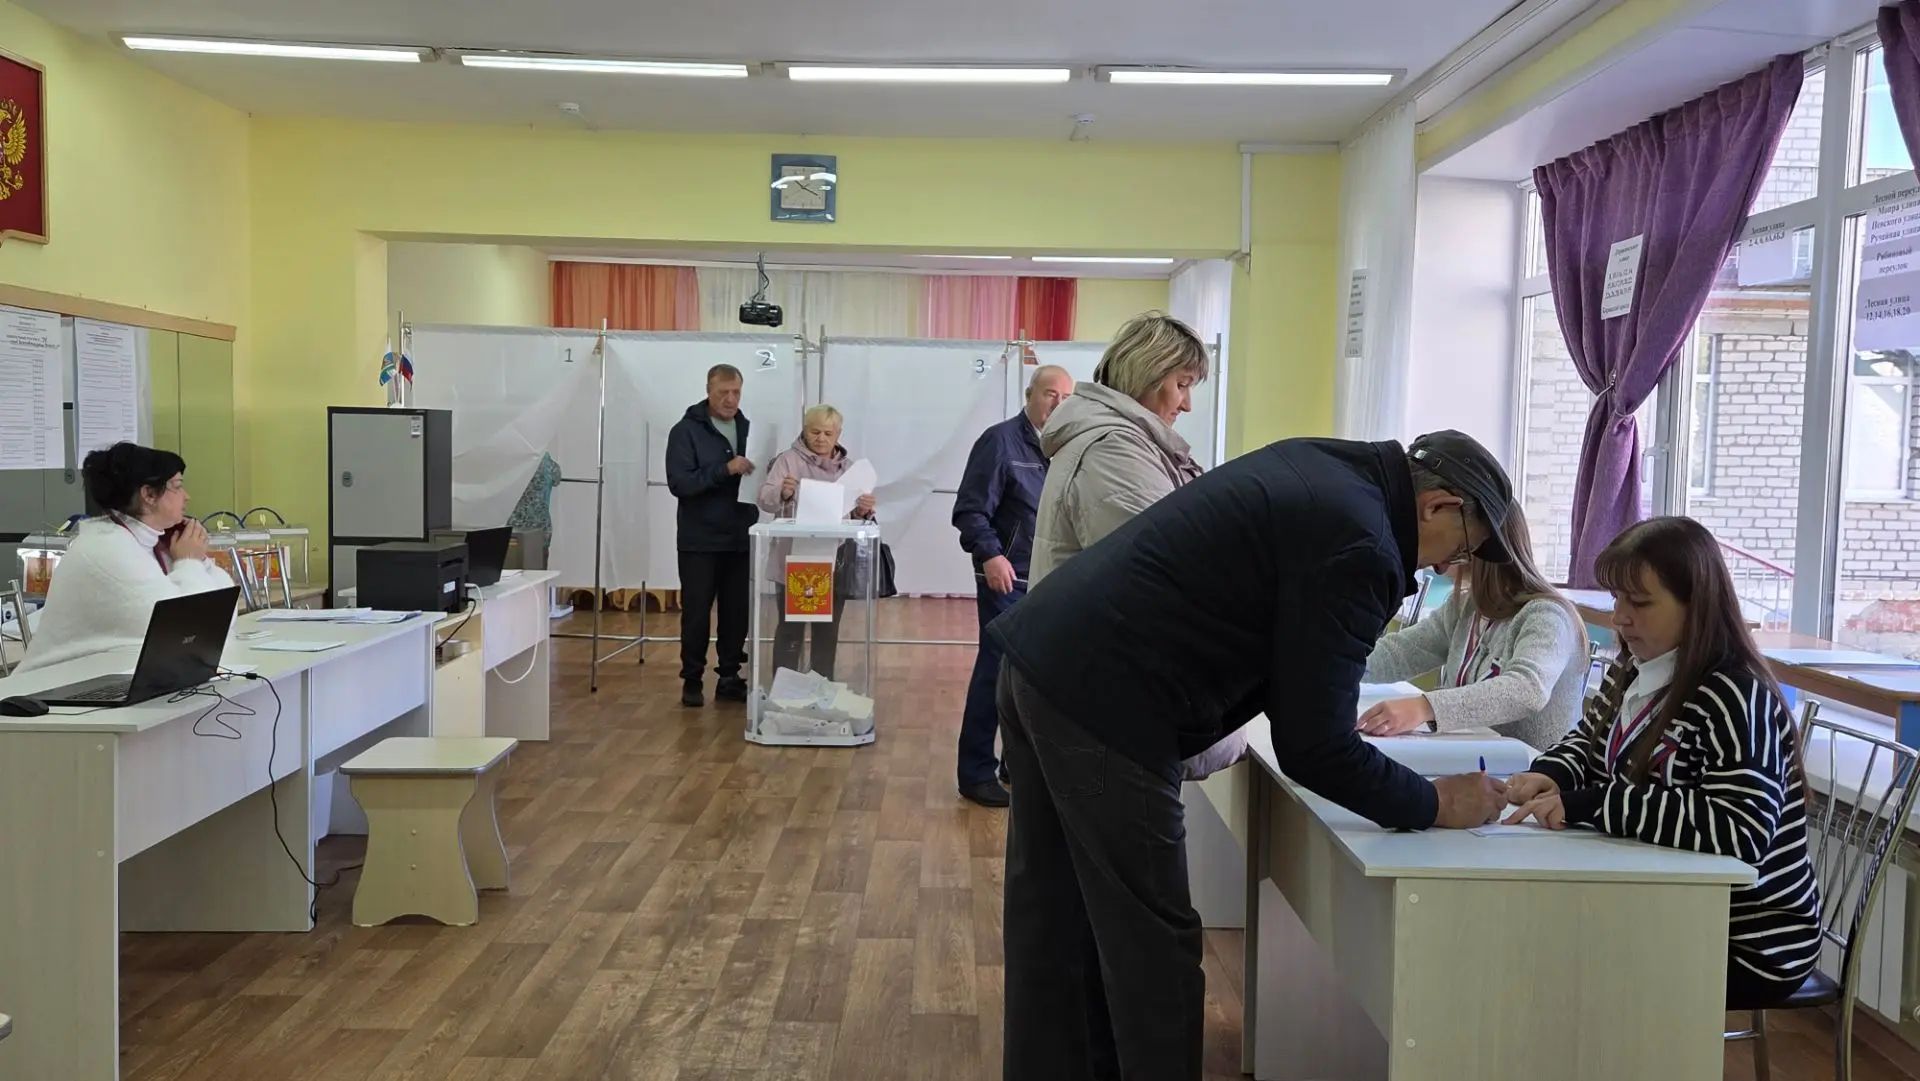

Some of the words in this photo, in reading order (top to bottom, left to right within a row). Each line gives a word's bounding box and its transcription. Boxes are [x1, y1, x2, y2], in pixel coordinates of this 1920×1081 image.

[1876, 246, 1913, 261] Рябиновый
[1879, 263, 1908, 274] переулок
[1865, 299, 1888, 309] Лесная
[1889, 295, 1910, 306] улица
[1866, 306, 1911, 321] 12,14,16,18,20
[565, 348, 574, 363] 1
[759, 351, 771, 366] 2
[976, 359, 985, 374] 3
